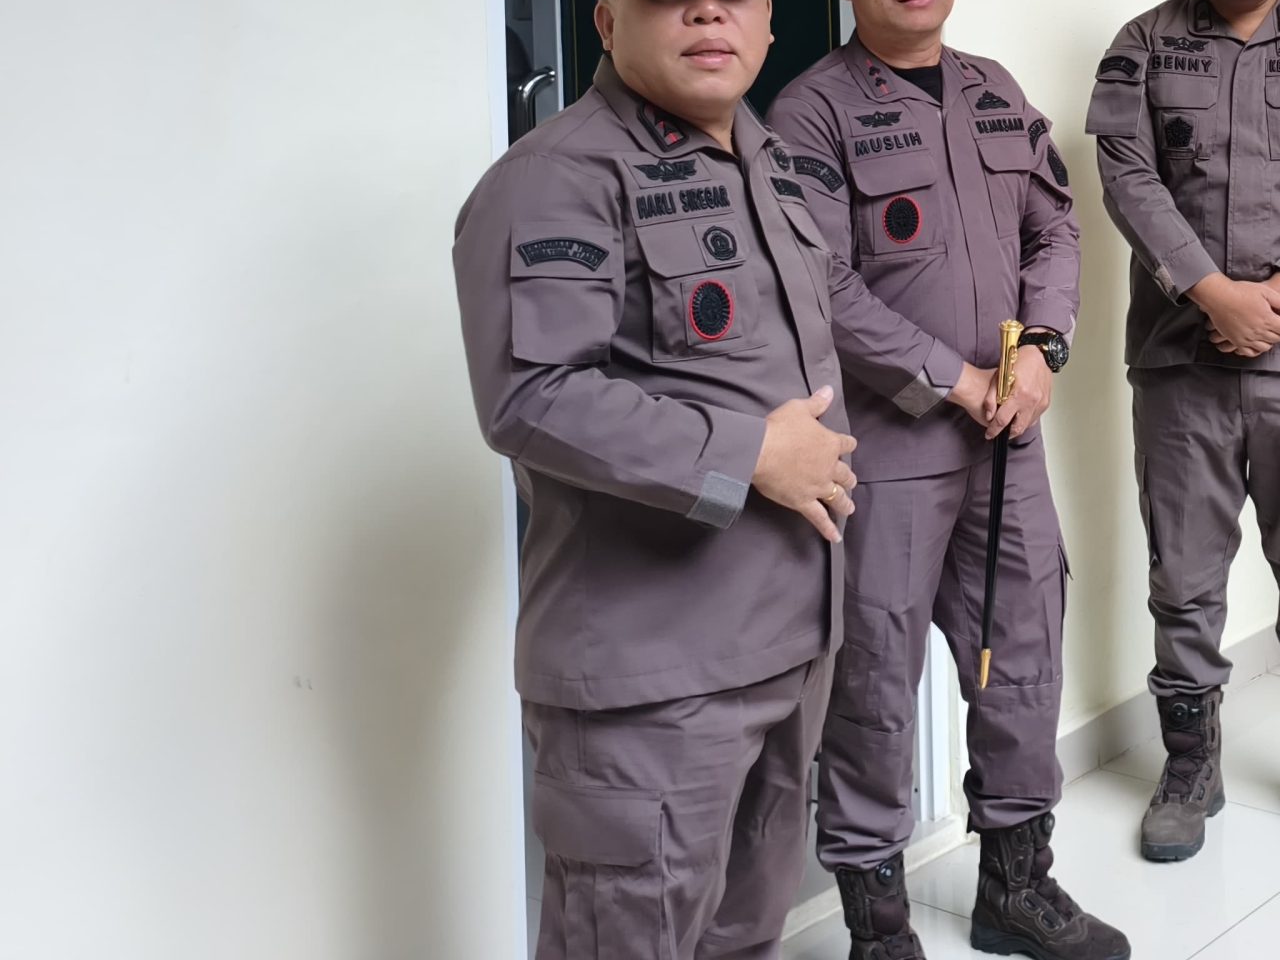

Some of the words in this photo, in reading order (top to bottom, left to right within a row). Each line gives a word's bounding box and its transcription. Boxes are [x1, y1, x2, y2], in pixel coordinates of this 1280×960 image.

[1151, 54, 1212, 73] BENNY
[854, 131, 923, 157] MUSLIH
[635, 191, 677, 220] HARLI
[679, 185, 731, 213] SIREGAR
